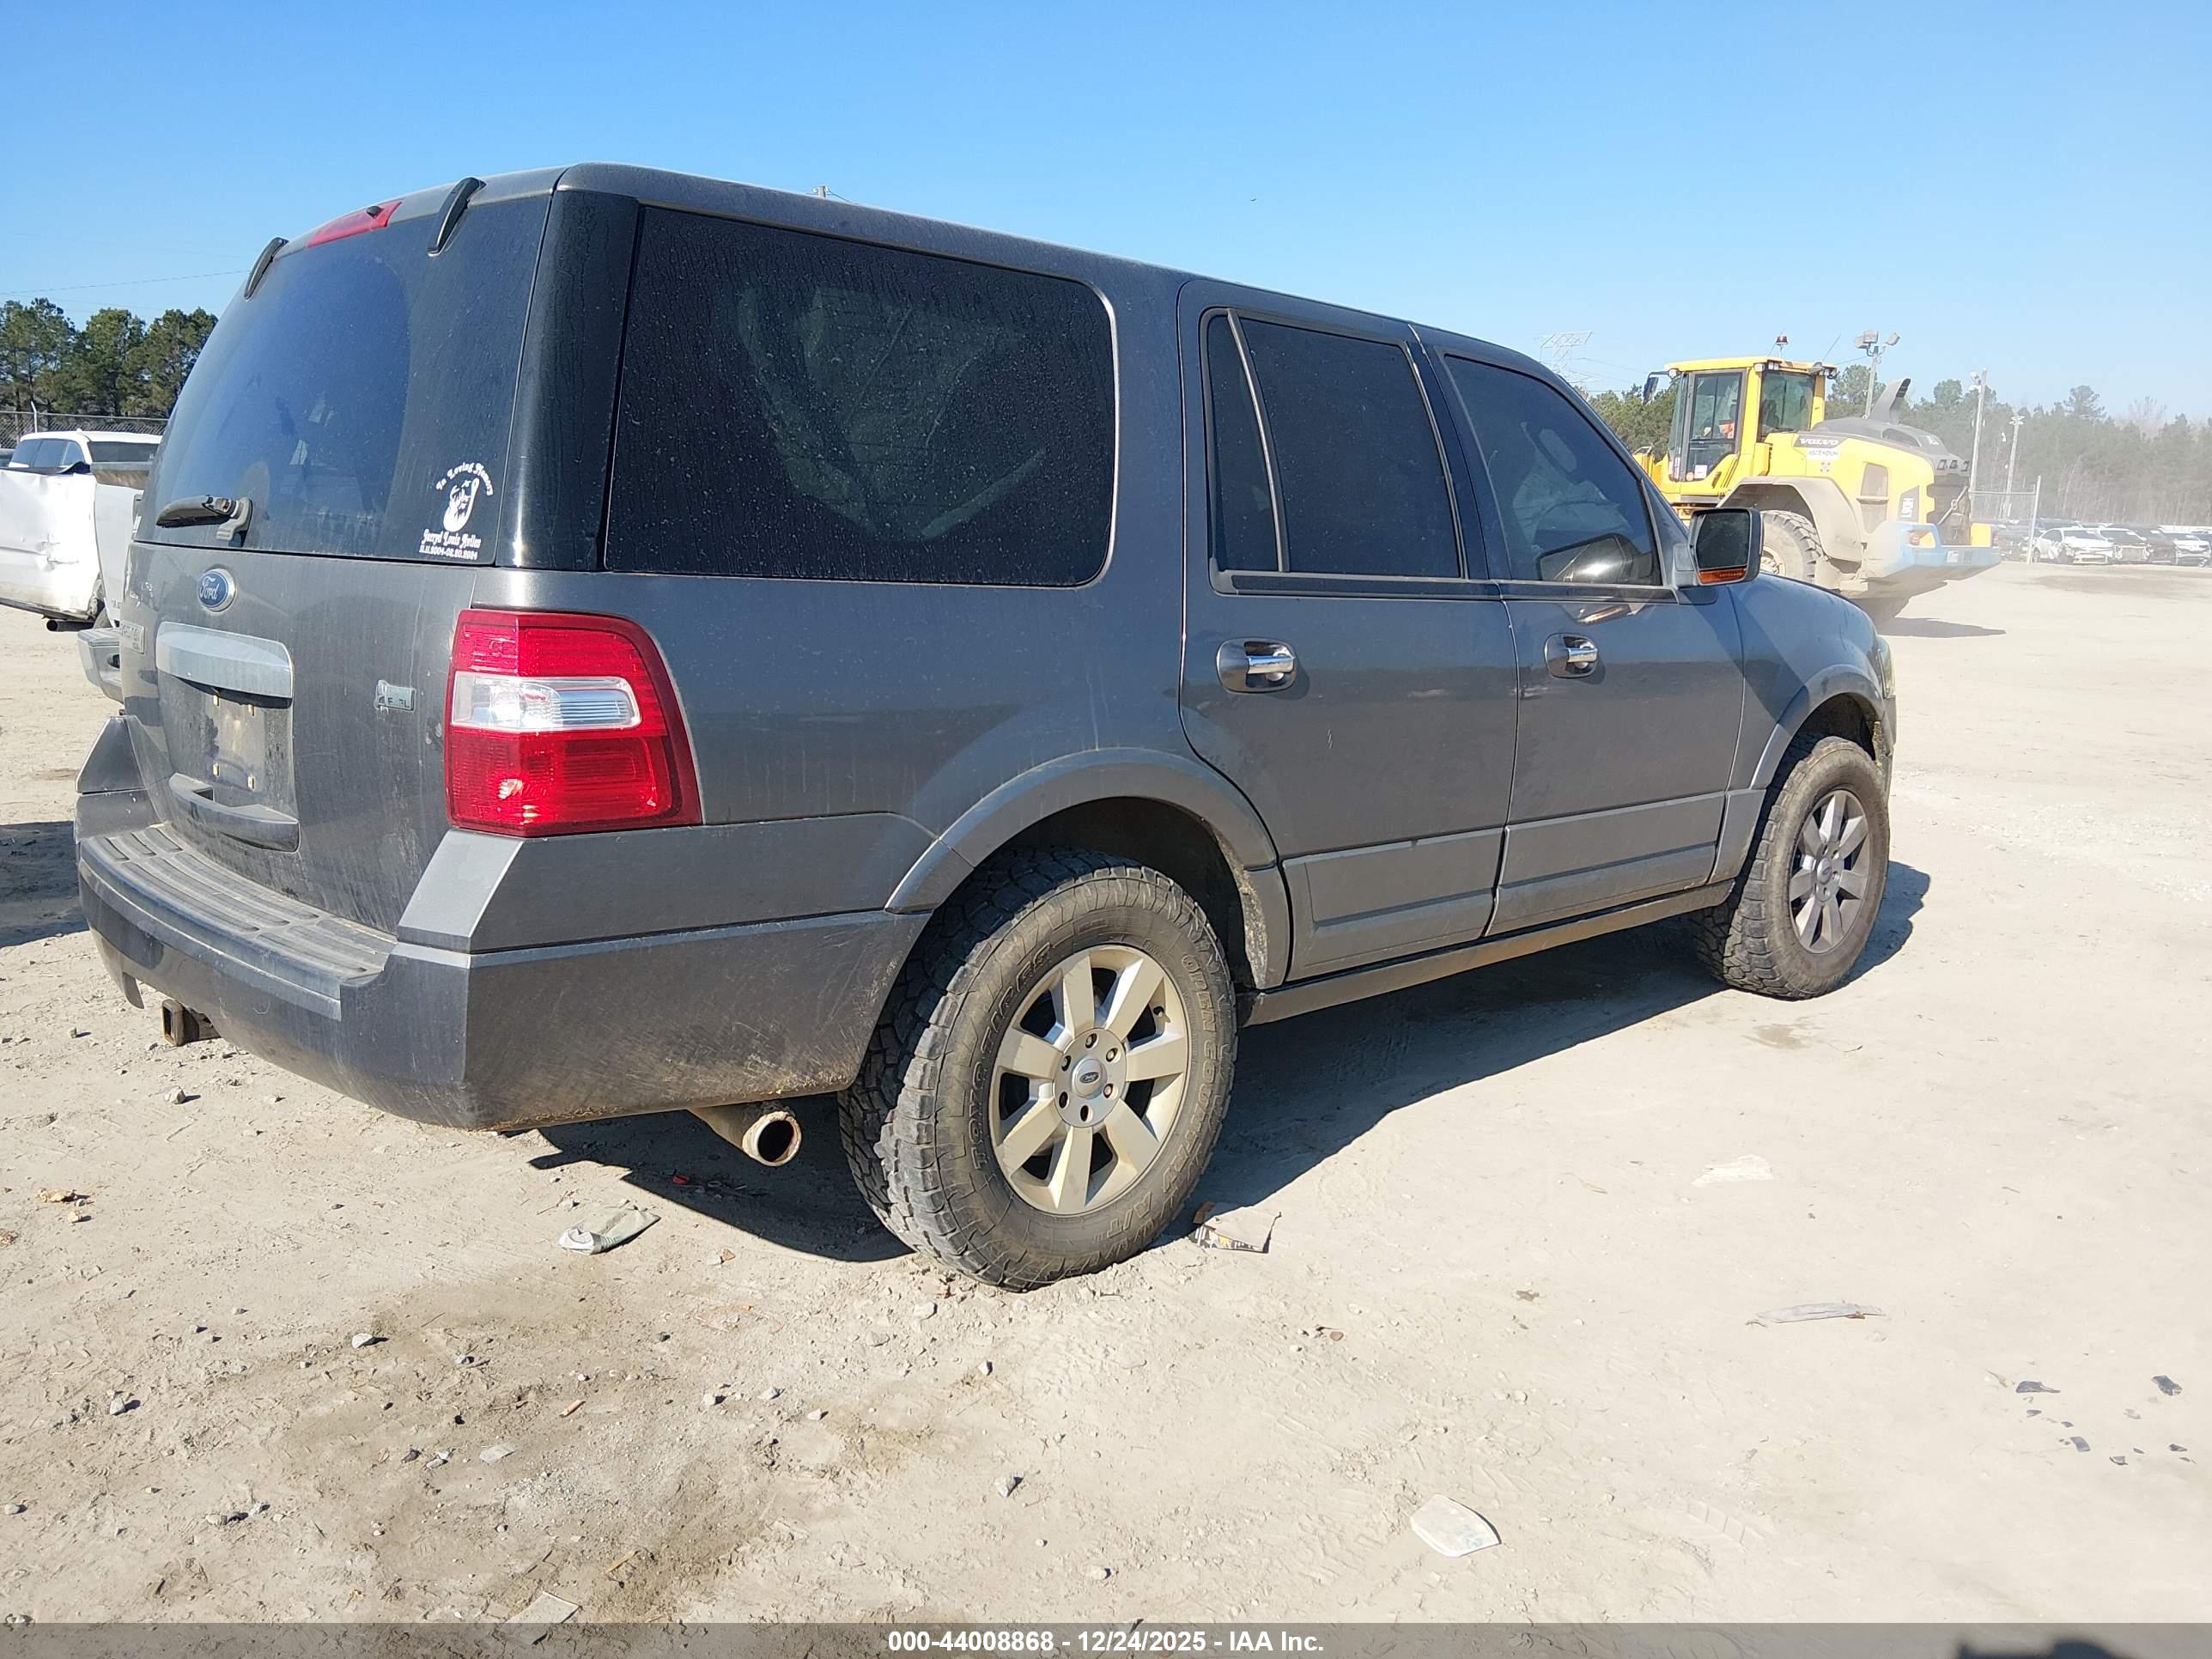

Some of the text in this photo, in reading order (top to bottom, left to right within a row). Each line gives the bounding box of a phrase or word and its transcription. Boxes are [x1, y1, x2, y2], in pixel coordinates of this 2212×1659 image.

[447, 462, 475, 480] Loving
[473, 462, 494, 496] Memory
[443, 531, 461, 546] Louis
[199, 575, 220, 600] Ford
[1182, 954, 1217, 1032] OPEN
[969, 942, 1052, 1170] TOYO TIRES
[1162, 1038, 1218, 1194] COUNTRY
[1106, 1190, 1152, 1238] A/T
